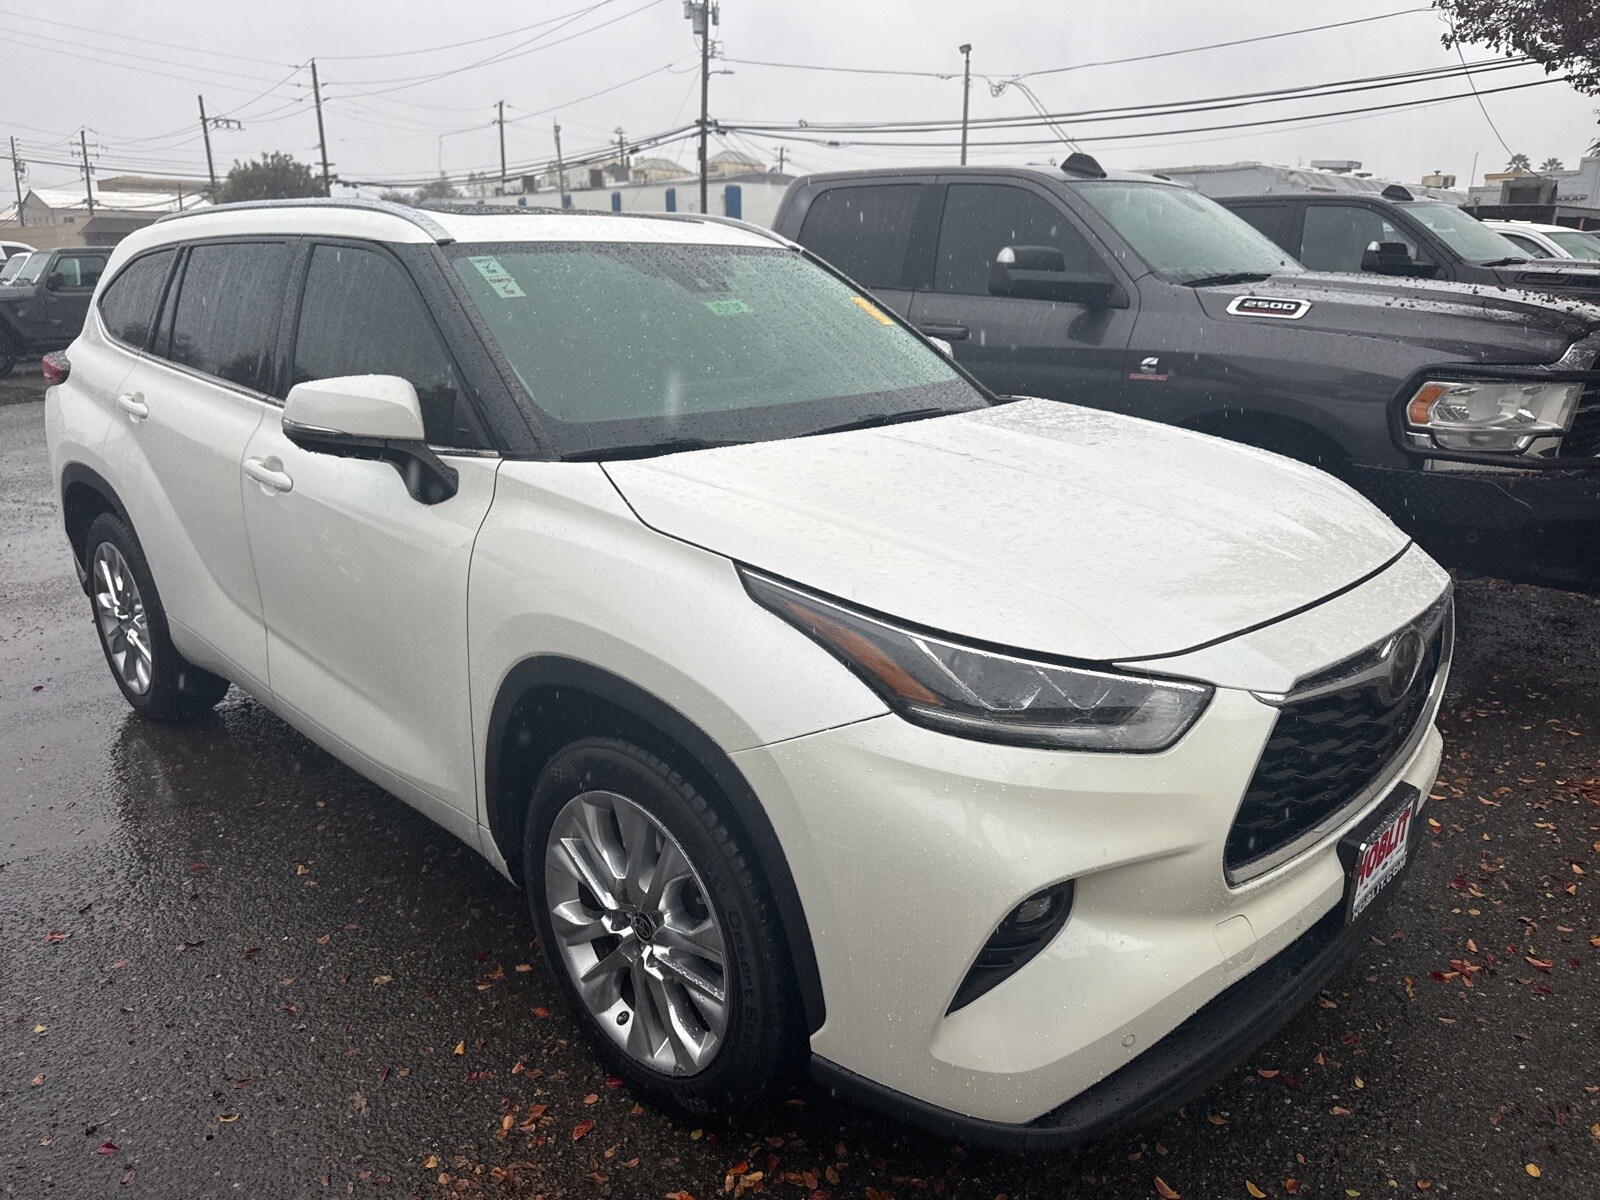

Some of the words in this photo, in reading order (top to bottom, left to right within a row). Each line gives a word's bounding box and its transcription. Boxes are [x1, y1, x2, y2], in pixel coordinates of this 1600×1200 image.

[1243, 300, 1296, 310] 2500
[1359, 806, 1412, 887] HOBLIT
[1352, 856, 1407, 922] HOBLIT.COM
